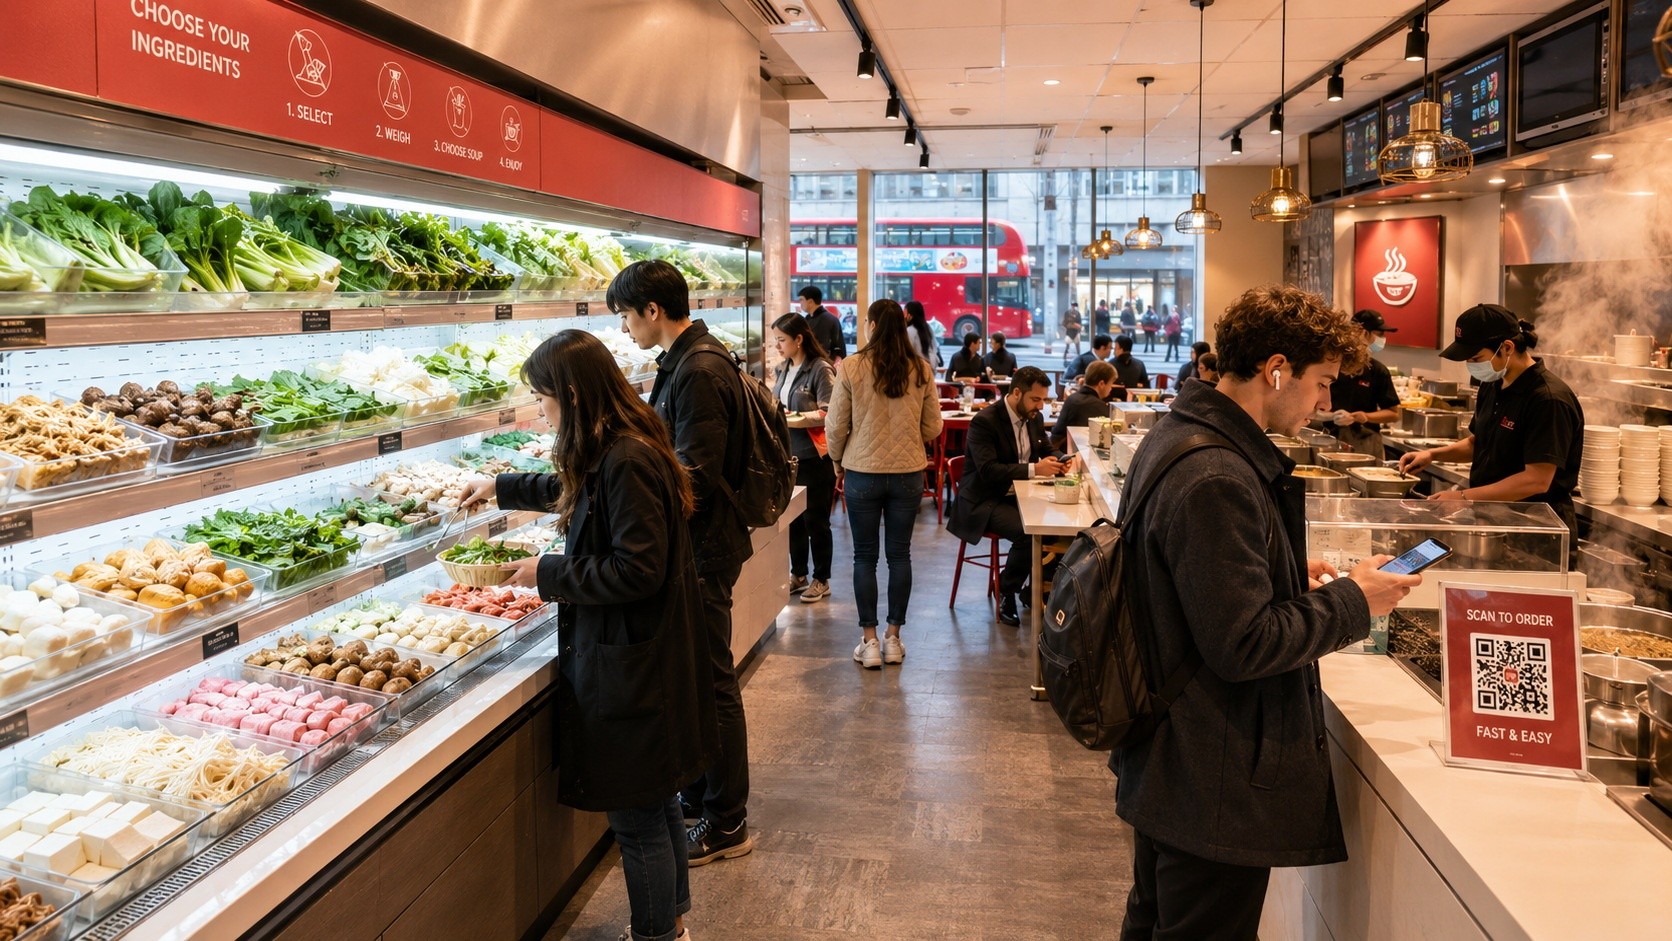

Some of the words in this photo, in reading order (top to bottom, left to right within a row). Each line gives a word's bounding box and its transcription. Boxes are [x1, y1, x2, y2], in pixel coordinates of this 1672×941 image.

[131, 0, 204, 38] CHOOSE
[208, 21, 250, 53] YOUR
[132, 29, 241, 79] INGREDIENTS
[286, 102, 295, 117] 1.
[297, 104, 333, 126] SELECT
[375, 124, 384, 138] 2.
[384, 126, 411, 145] WEIGH
[434, 139, 440, 152] 3.
[441, 141, 467, 158] CHOOSE
[467, 148, 483, 161] SOUP
[505, 158, 523, 171] ENJOY
[1466, 608, 1496, 622] SCAN
[1498, 611, 1513, 624] TO
[1515, 613, 1554, 627] ORDER
[1476, 725, 1506, 740] FAST
[1508, 728, 1518, 741] &
[1521, 730, 1552, 745] EASY
